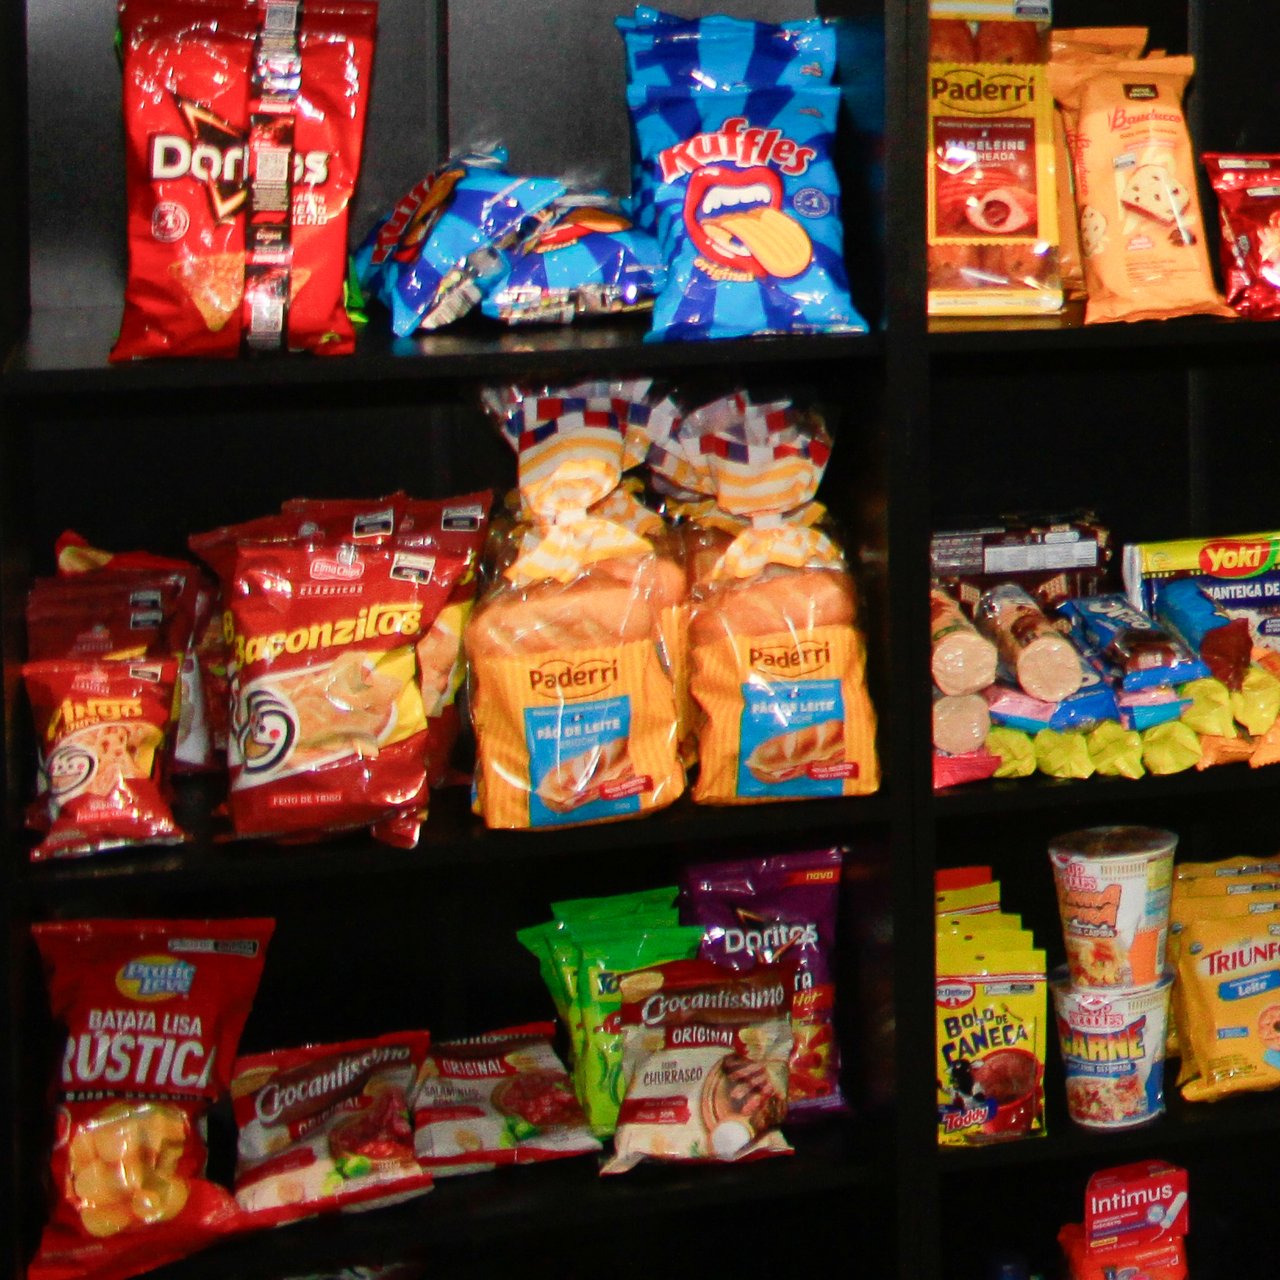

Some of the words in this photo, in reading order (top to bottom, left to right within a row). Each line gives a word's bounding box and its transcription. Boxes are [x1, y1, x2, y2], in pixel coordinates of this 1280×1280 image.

[658, 116, 818, 186] Ruffles
[1264, 582, 1280, 597] DE
[798, 698, 835, 712] LEITE
[583, 718, 621, 735] LEITE
[724, 923, 818, 955] Doritos
[88, 1009, 156, 1032] BATATA
[163, 1012, 203, 1037] LISA
[672, 1026, 734, 1047] ORIGINAL
[944, 1007, 996, 1040] BOLO
[941, 1021, 1030, 1065] CANECA
[944, 1106, 988, 1135] Toddy
[1091, 1183, 1173, 1215] Intimus
